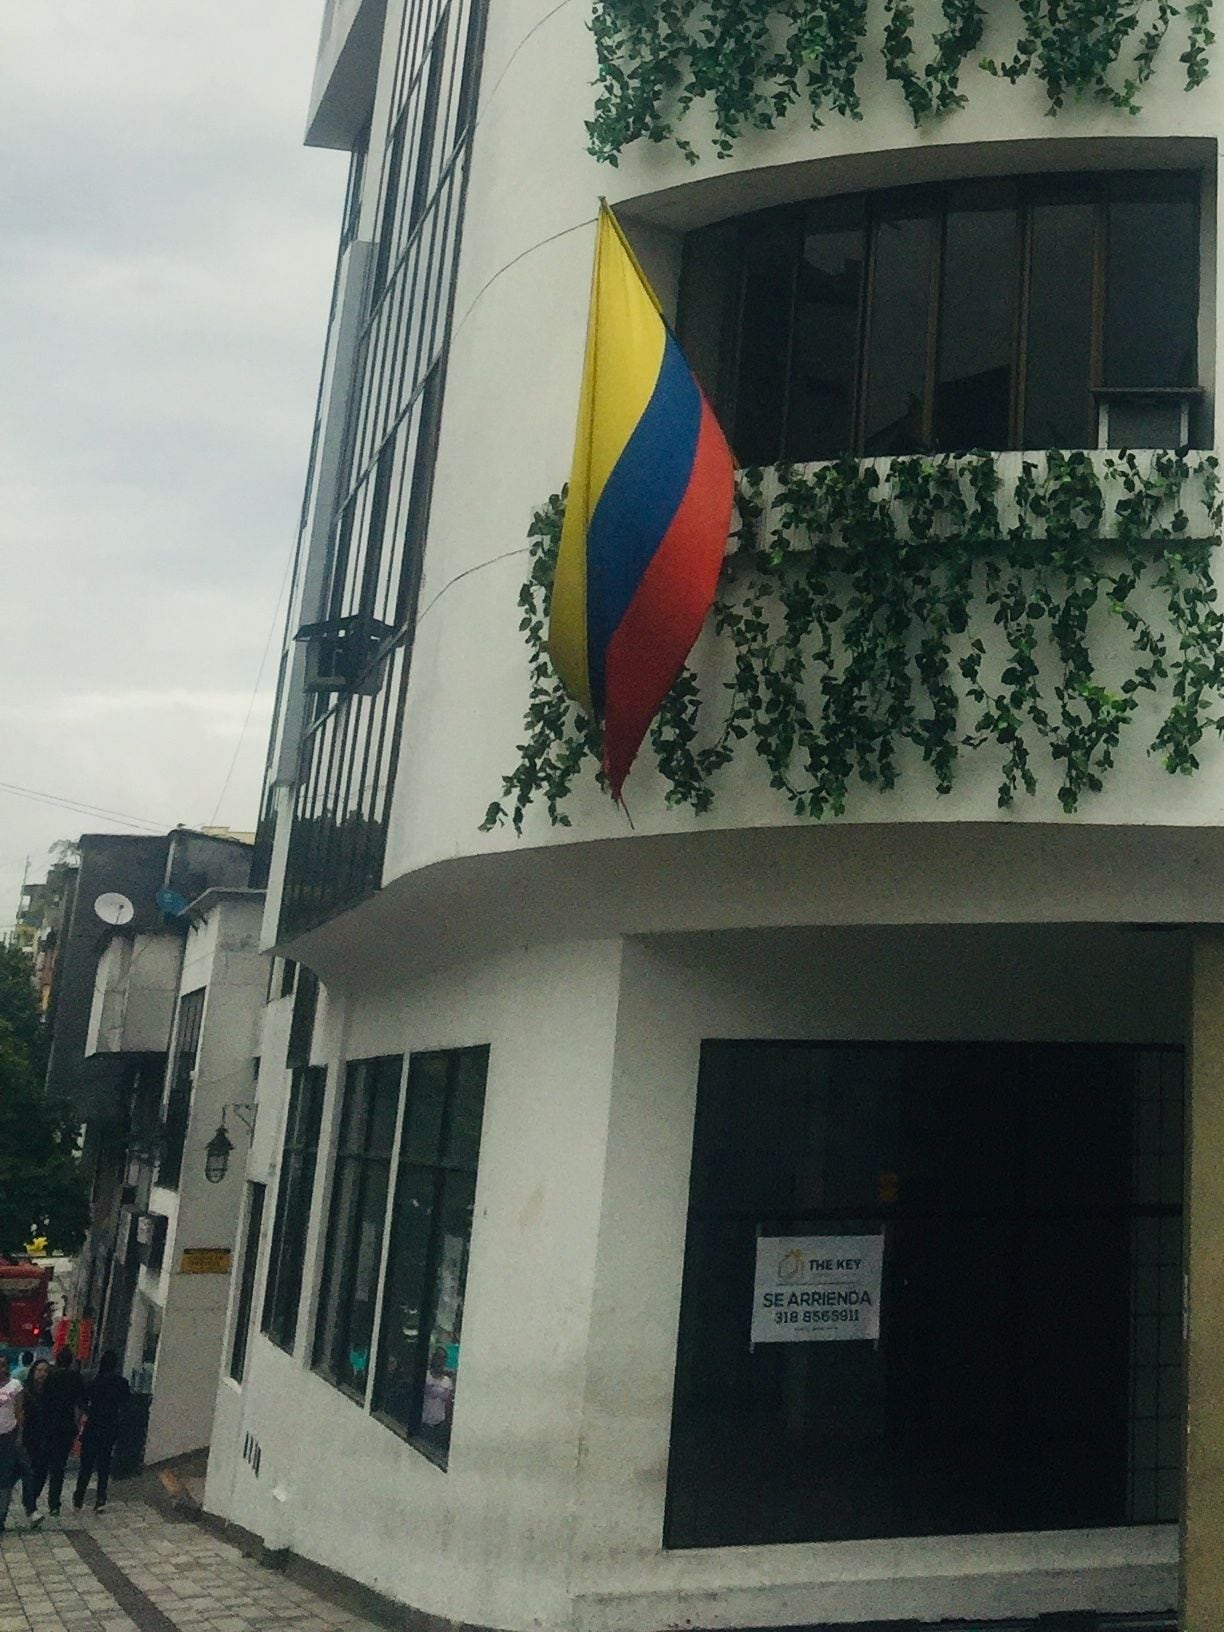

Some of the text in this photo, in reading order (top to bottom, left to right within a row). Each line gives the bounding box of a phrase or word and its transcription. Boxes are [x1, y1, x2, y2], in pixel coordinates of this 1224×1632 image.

[809, 1259, 862, 1272] THE KEY
[763, 1291, 872, 1308] SE ARRIENDA
[775, 1312, 798, 1325] 318
